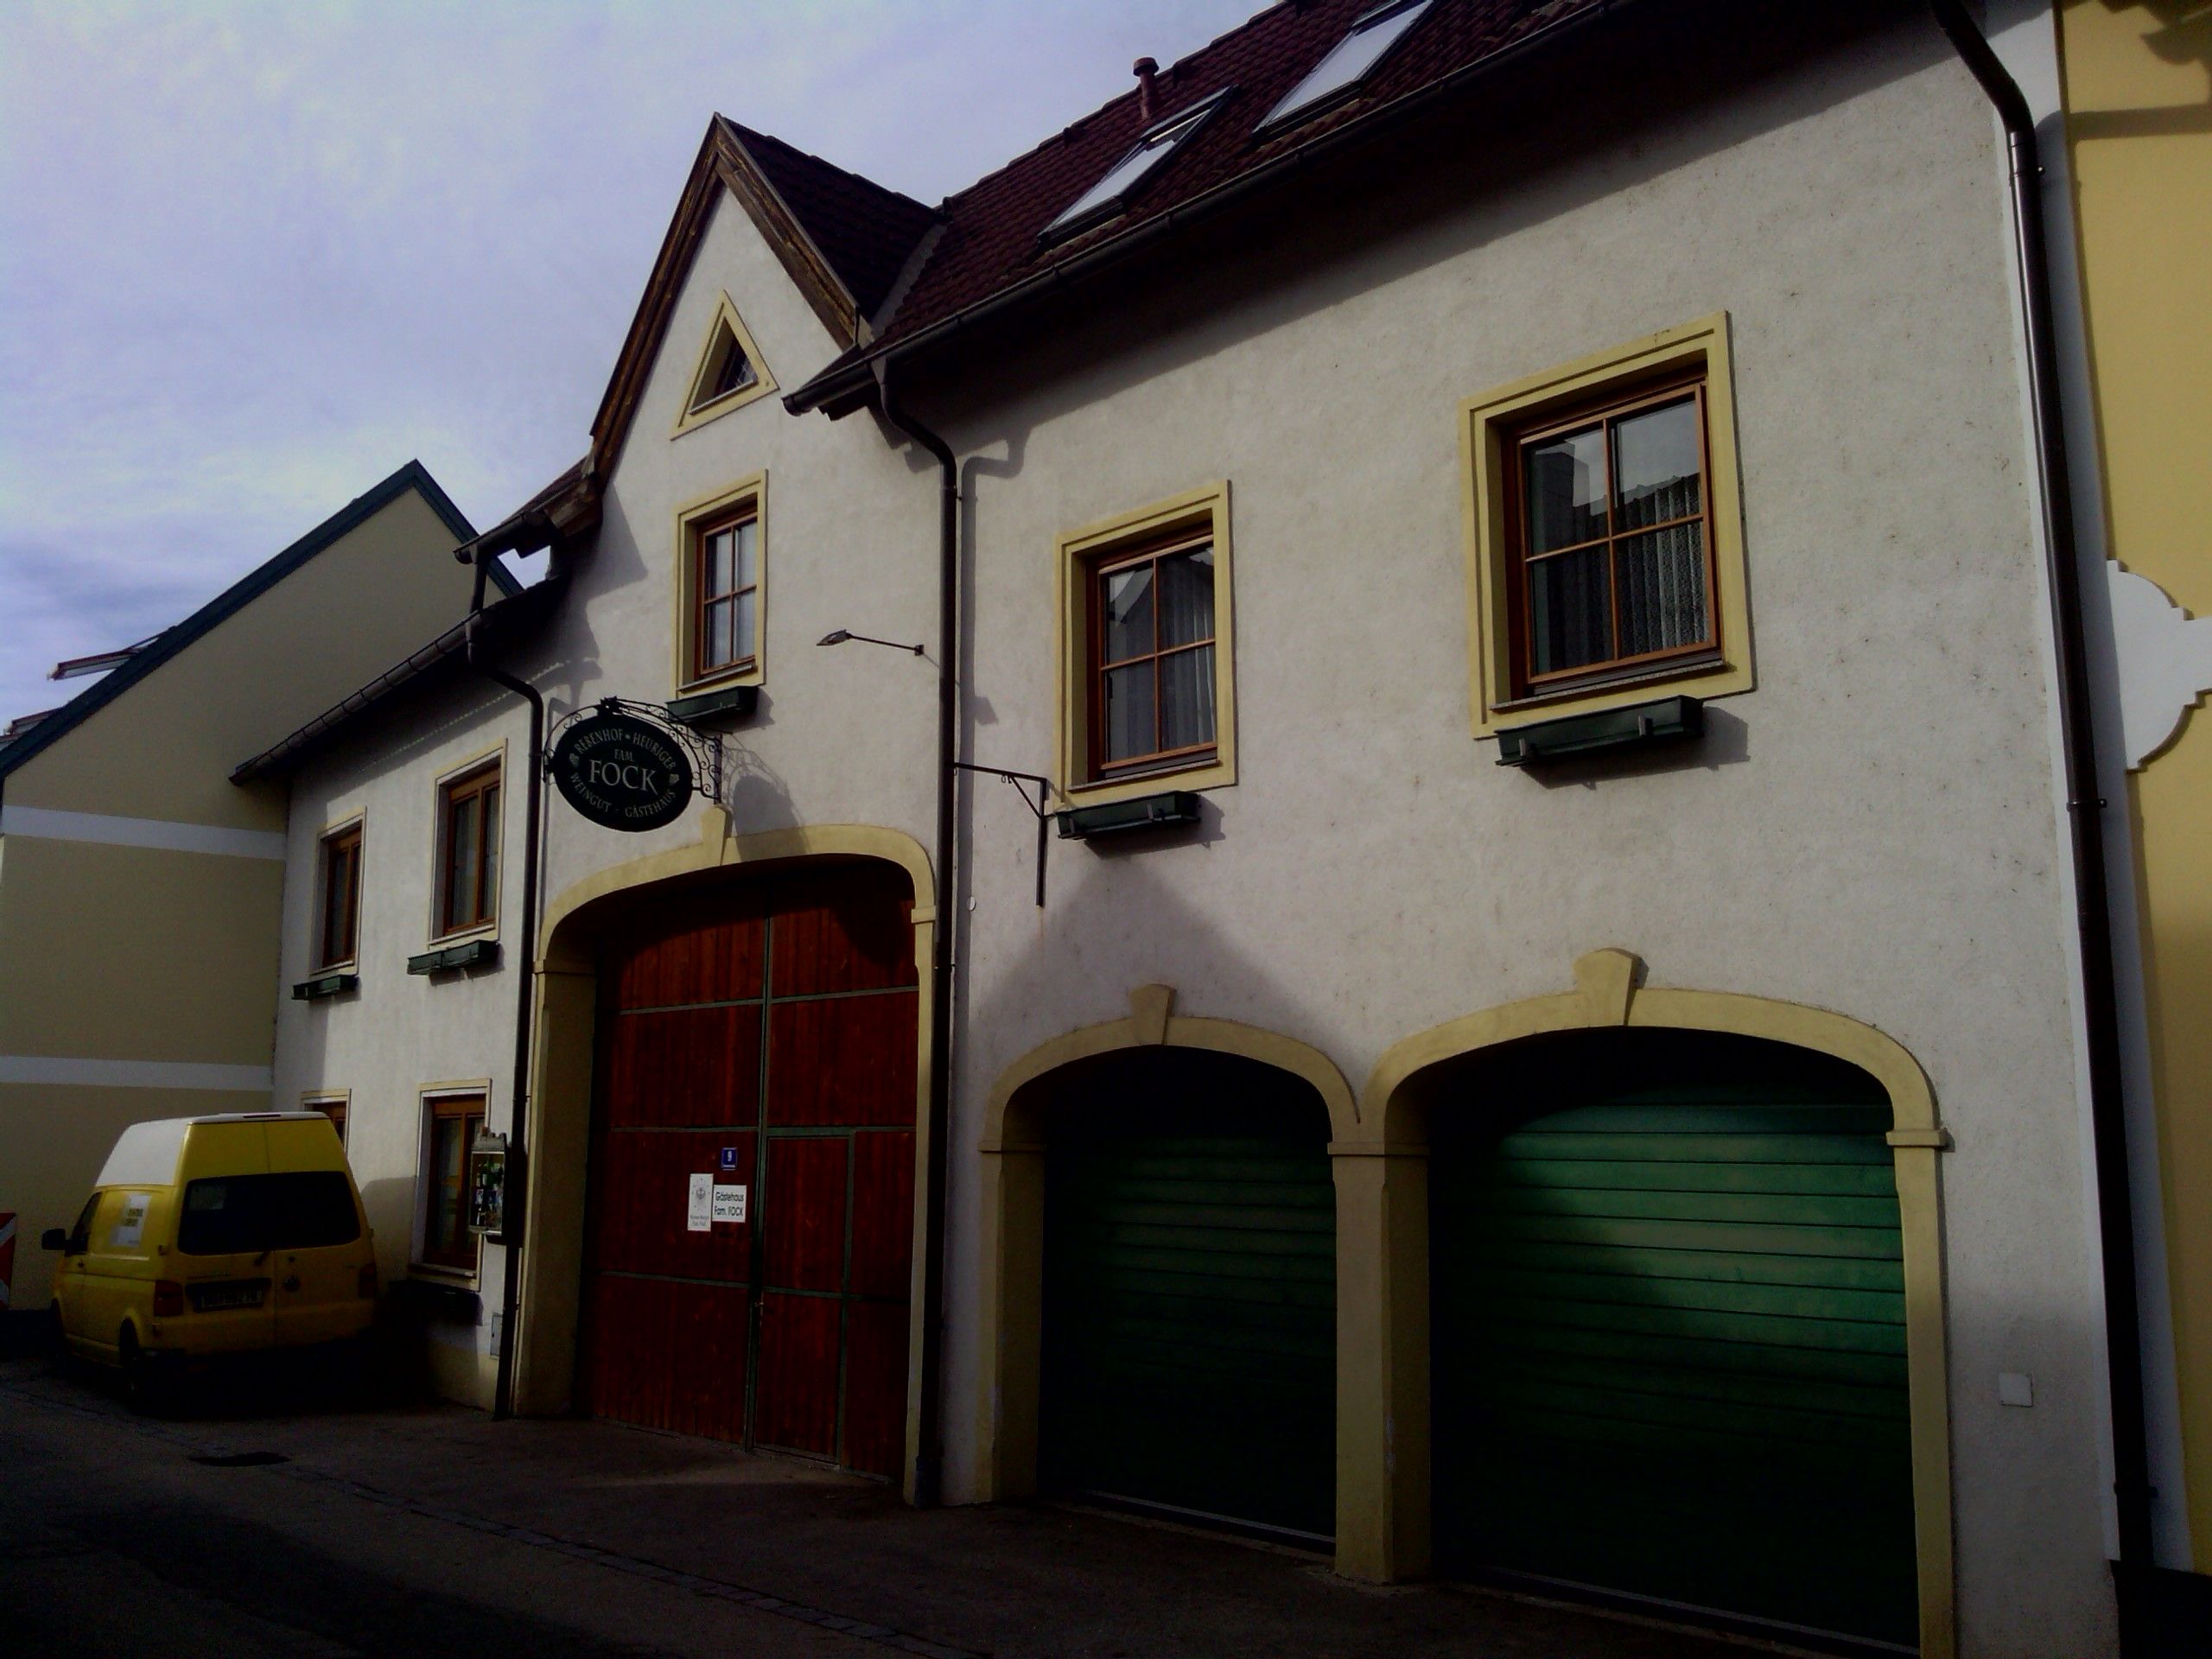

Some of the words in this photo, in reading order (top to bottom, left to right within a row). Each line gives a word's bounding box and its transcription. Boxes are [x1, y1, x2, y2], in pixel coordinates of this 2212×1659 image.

[574, 728, 623, 754] REBENHOF
[632, 732, 677, 770] HEURIGER
[569, 772, 613, 812] WEINGUT
[588, 759, 658, 796] FOCK
[728, 1205, 744, 1217] FOCK
